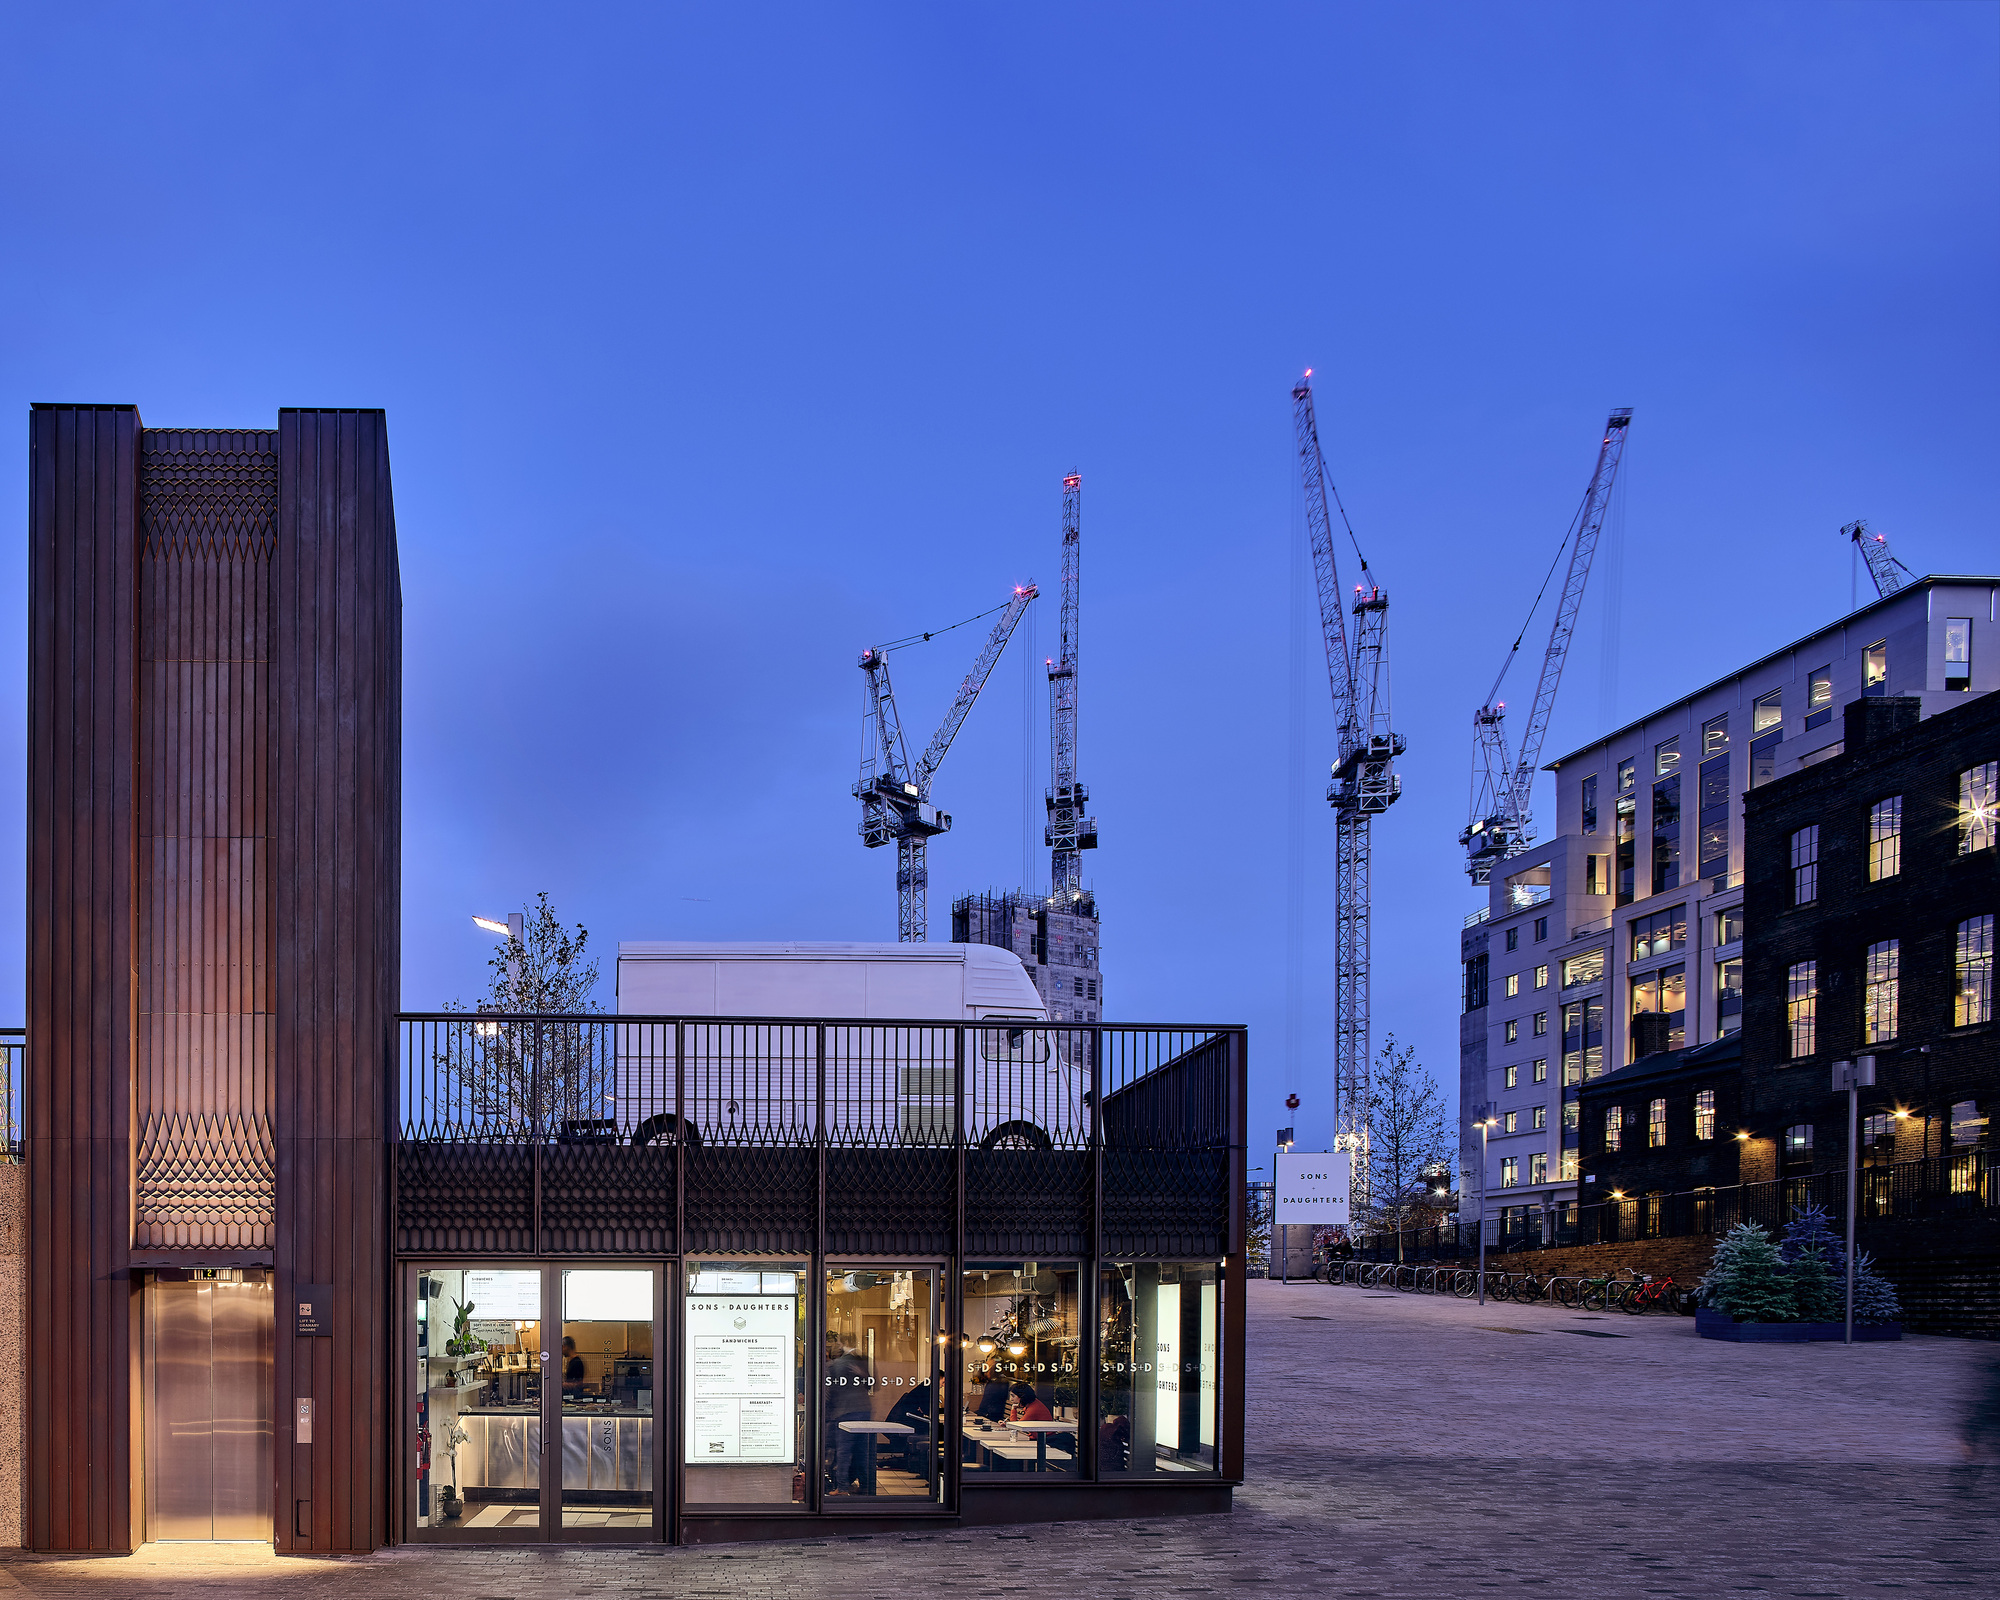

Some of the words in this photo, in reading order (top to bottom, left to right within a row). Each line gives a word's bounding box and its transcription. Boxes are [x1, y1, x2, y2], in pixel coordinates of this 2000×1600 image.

[1626, 1114, 1635, 1124] 15
[967, 1363, 989, 1372] S+D
[995, 1363, 1017, 1372] S+D
[1023, 1363, 1045, 1372] S+D
[1051, 1363, 1073, 1372] S+D
[1102, 1362, 1125, 1372] S+D
[1130, 1362, 1152, 1372] S+D
[604, 1340, 612, 1406] DAUGHTERS
[825, 1376, 847, 1386] S+D
[853, 1376, 875, 1386] S+D
[881, 1376, 904, 1386] S+D
[909, 1376, 931, 1386] S+D
[604, 1420, 612, 1451] SONS
